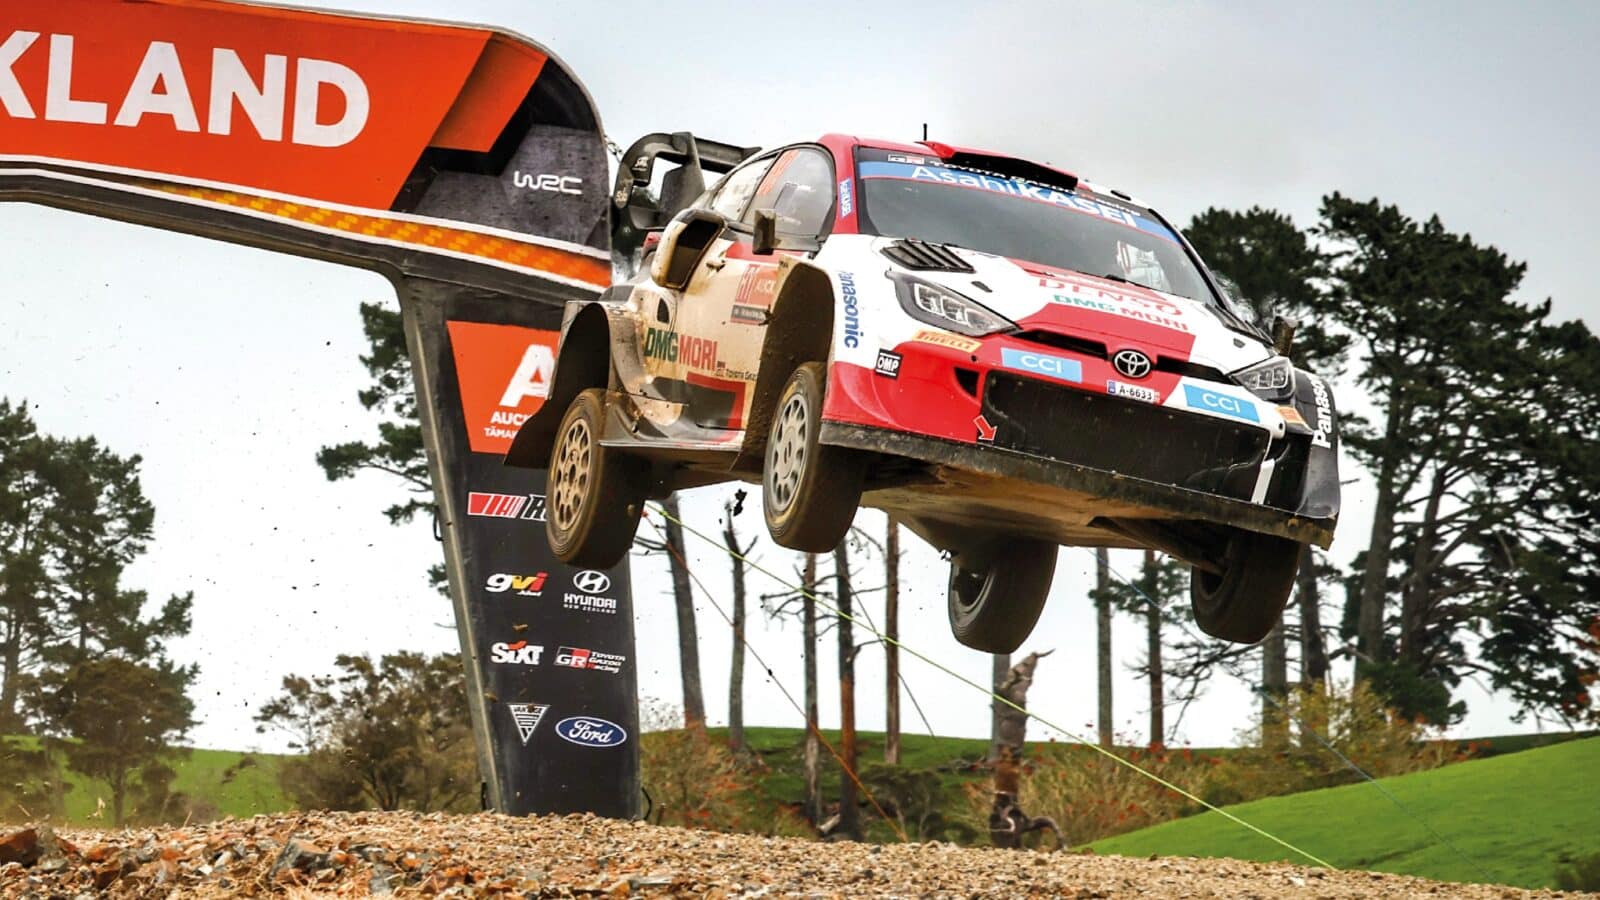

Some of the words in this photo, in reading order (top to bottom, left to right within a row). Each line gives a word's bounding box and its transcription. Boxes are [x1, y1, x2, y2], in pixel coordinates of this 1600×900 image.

[513, 170, 582, 195] WRC
[1053, 294, 1115, 312] DMG
[1120, 307, 1188, 330] MORI
[645, 328, 679, 362] DMG
[679, 334, 718, 371] MORI
[917, 331, 975, 350] PIRELLI
[877, 357, 899, 372] OMP
[1021, 355, 1062, 374] CCI
[1202, 392, 1240, 413] CCI
[484, 571, 549, 593] gvi
[563, 593, 617, 609] HYUNDAI
[582, 605, 616, 614] ZEALAND
[556, 654, 587, 668] GR
[567, 720, 613, 743] Ford
